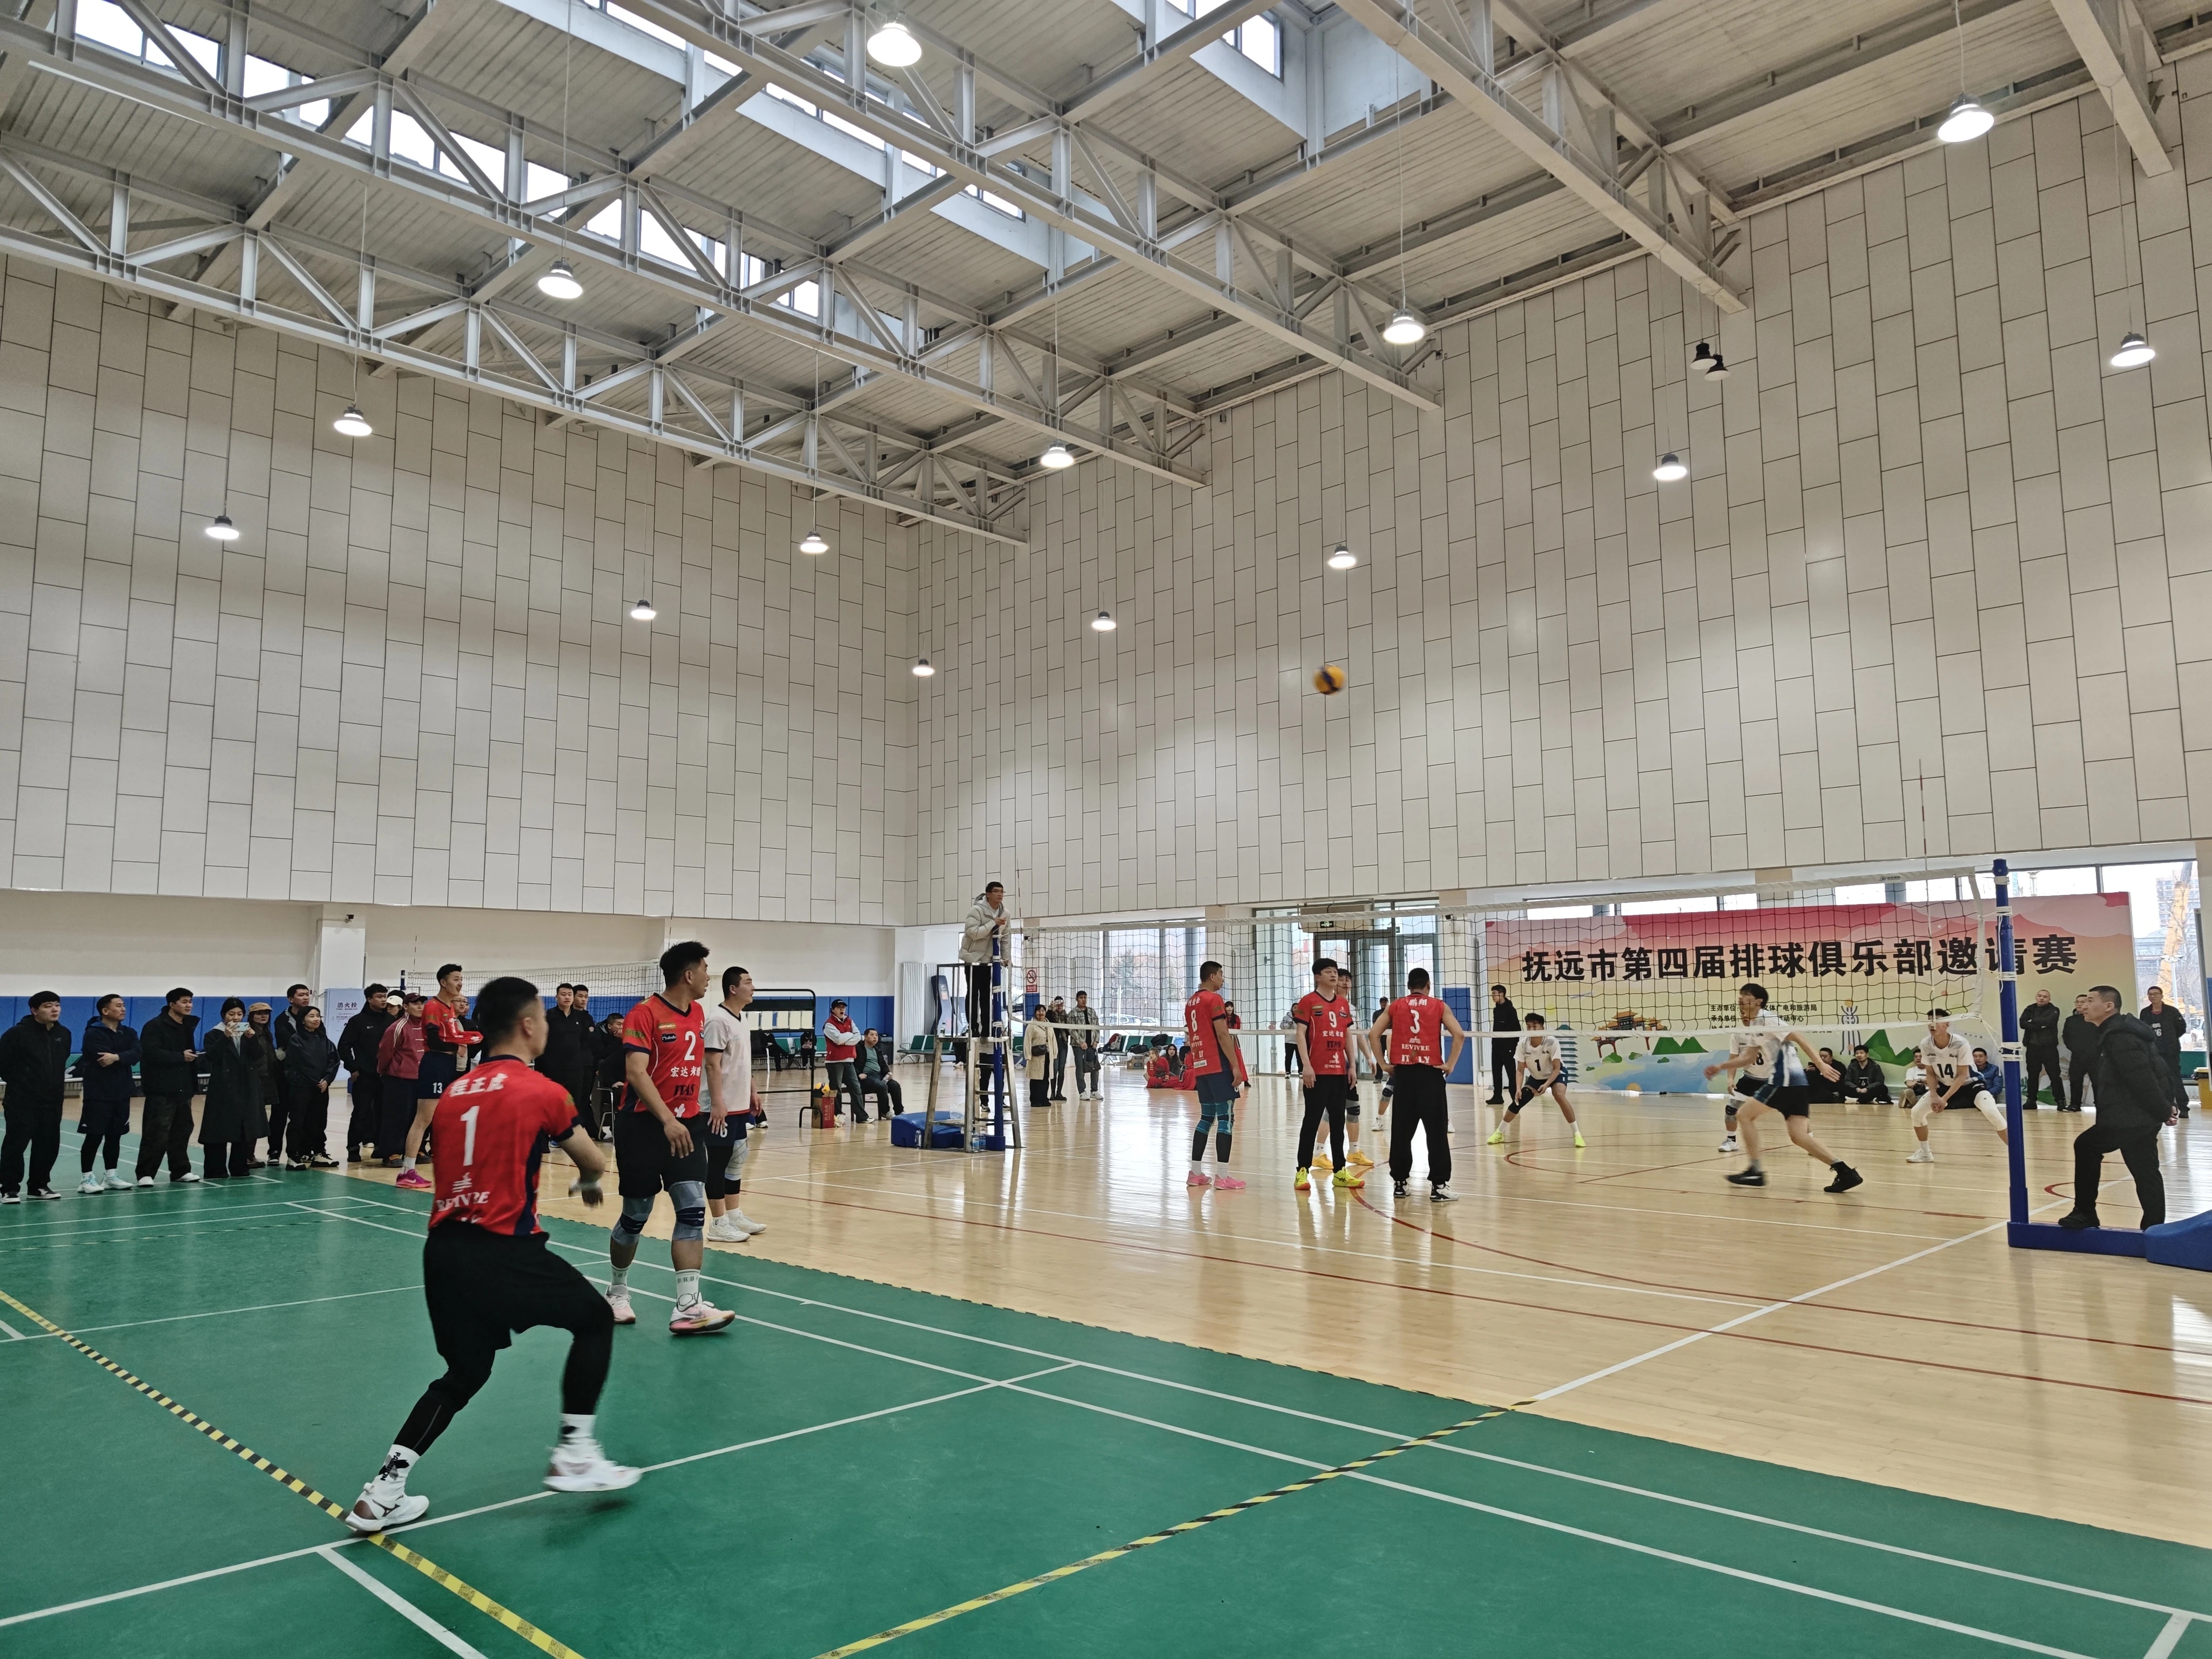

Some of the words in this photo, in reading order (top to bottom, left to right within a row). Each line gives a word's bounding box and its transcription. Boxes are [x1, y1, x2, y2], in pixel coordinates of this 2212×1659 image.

[1522, 934, 2078, 982] 抚远市第四届排球俱乐部邀请赛
[1191, 1009, 1198, 1032] 8
[1328, 1011, 1337, 1028] 9
[1410, 1009, 1420, 1034] 3
[684, 1030, 696, 1061] 2
[1534, 1059, 1541, 1072] 1
[1937, 1063, 1954, 1079] 14
[433, 1082, 442, 1094] 13
[460, 1105, 480, 1166] 1
[720, 1122, 728, 1138] 6
